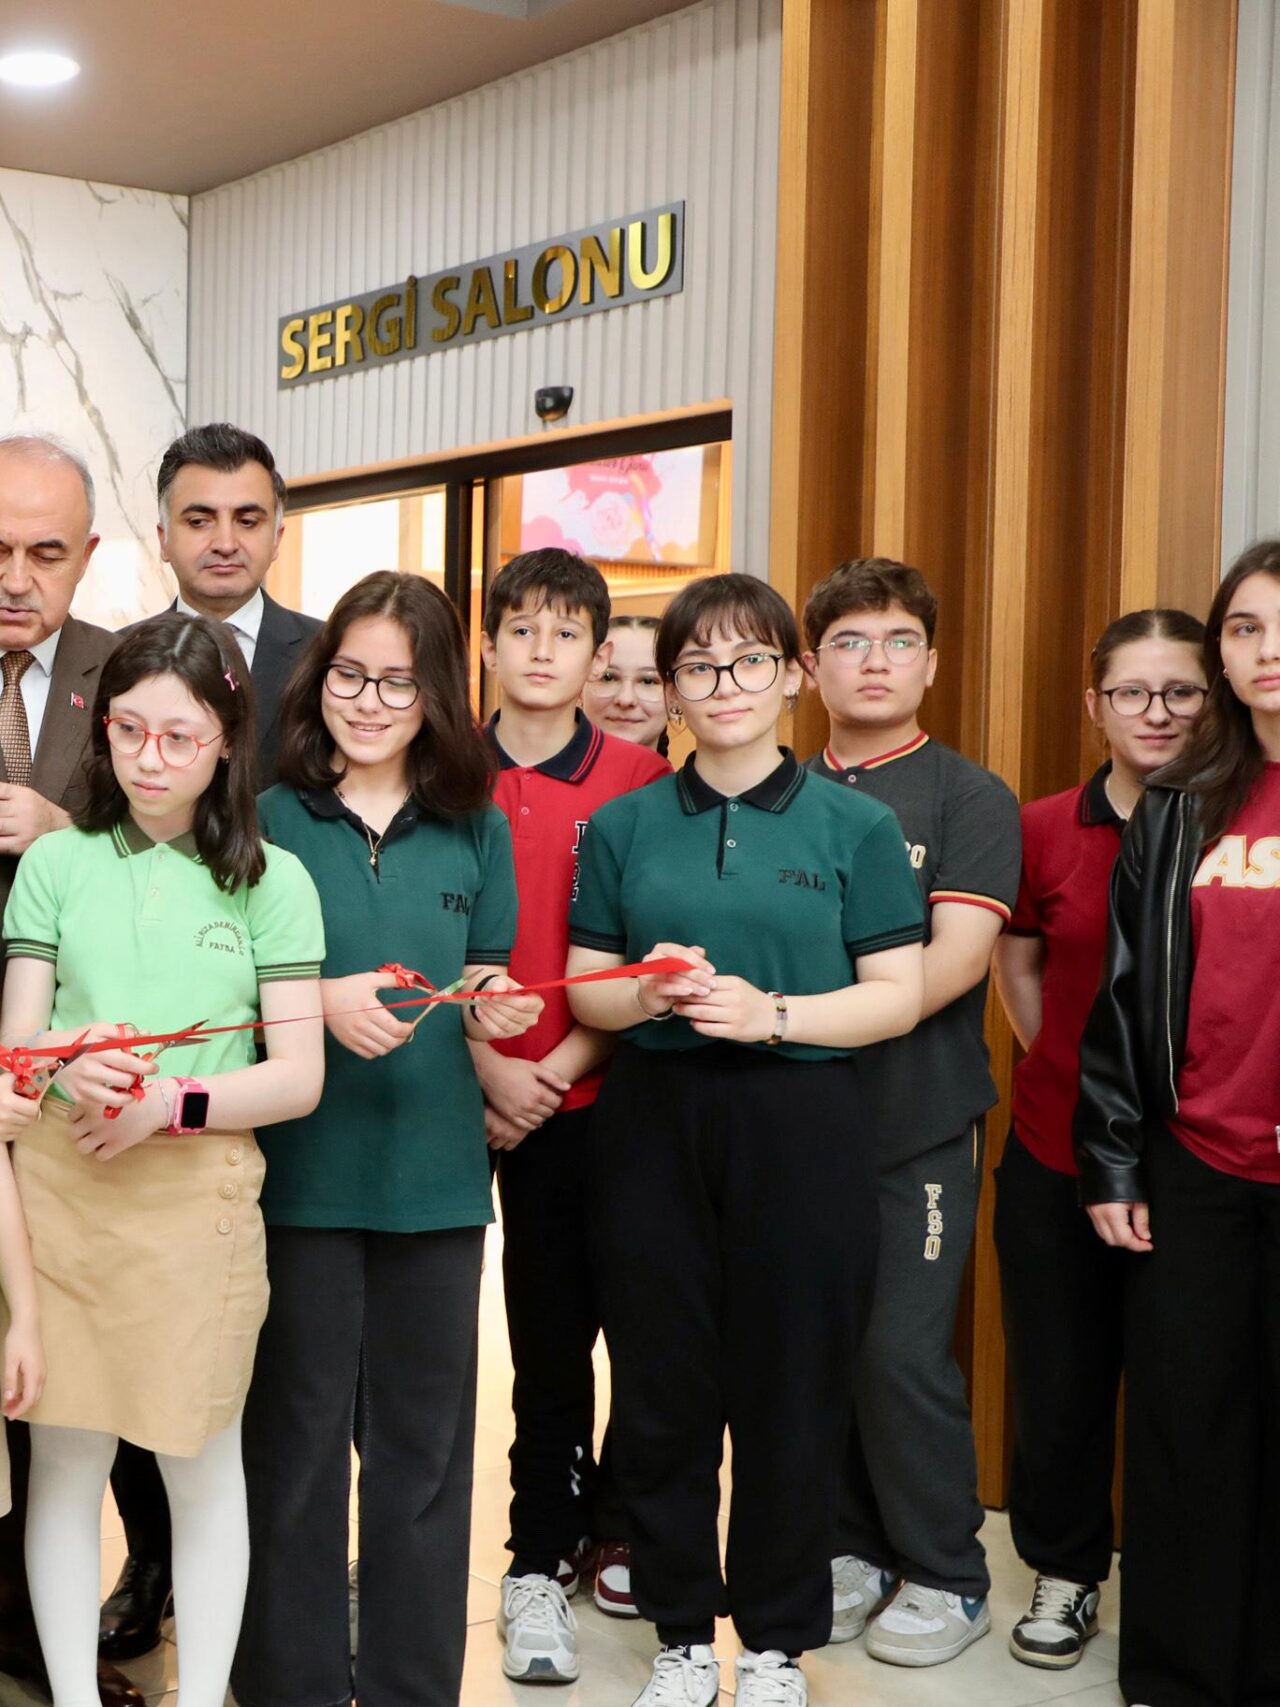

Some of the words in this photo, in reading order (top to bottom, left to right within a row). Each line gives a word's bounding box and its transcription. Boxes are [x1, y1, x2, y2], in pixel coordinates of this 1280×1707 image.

[280, 275, 417, 381] SERGİ
[431, 212, 677, 344] SALONU
[778, 868, 826, 891] FAL
[923, 1183, 943, 1261] FSO
